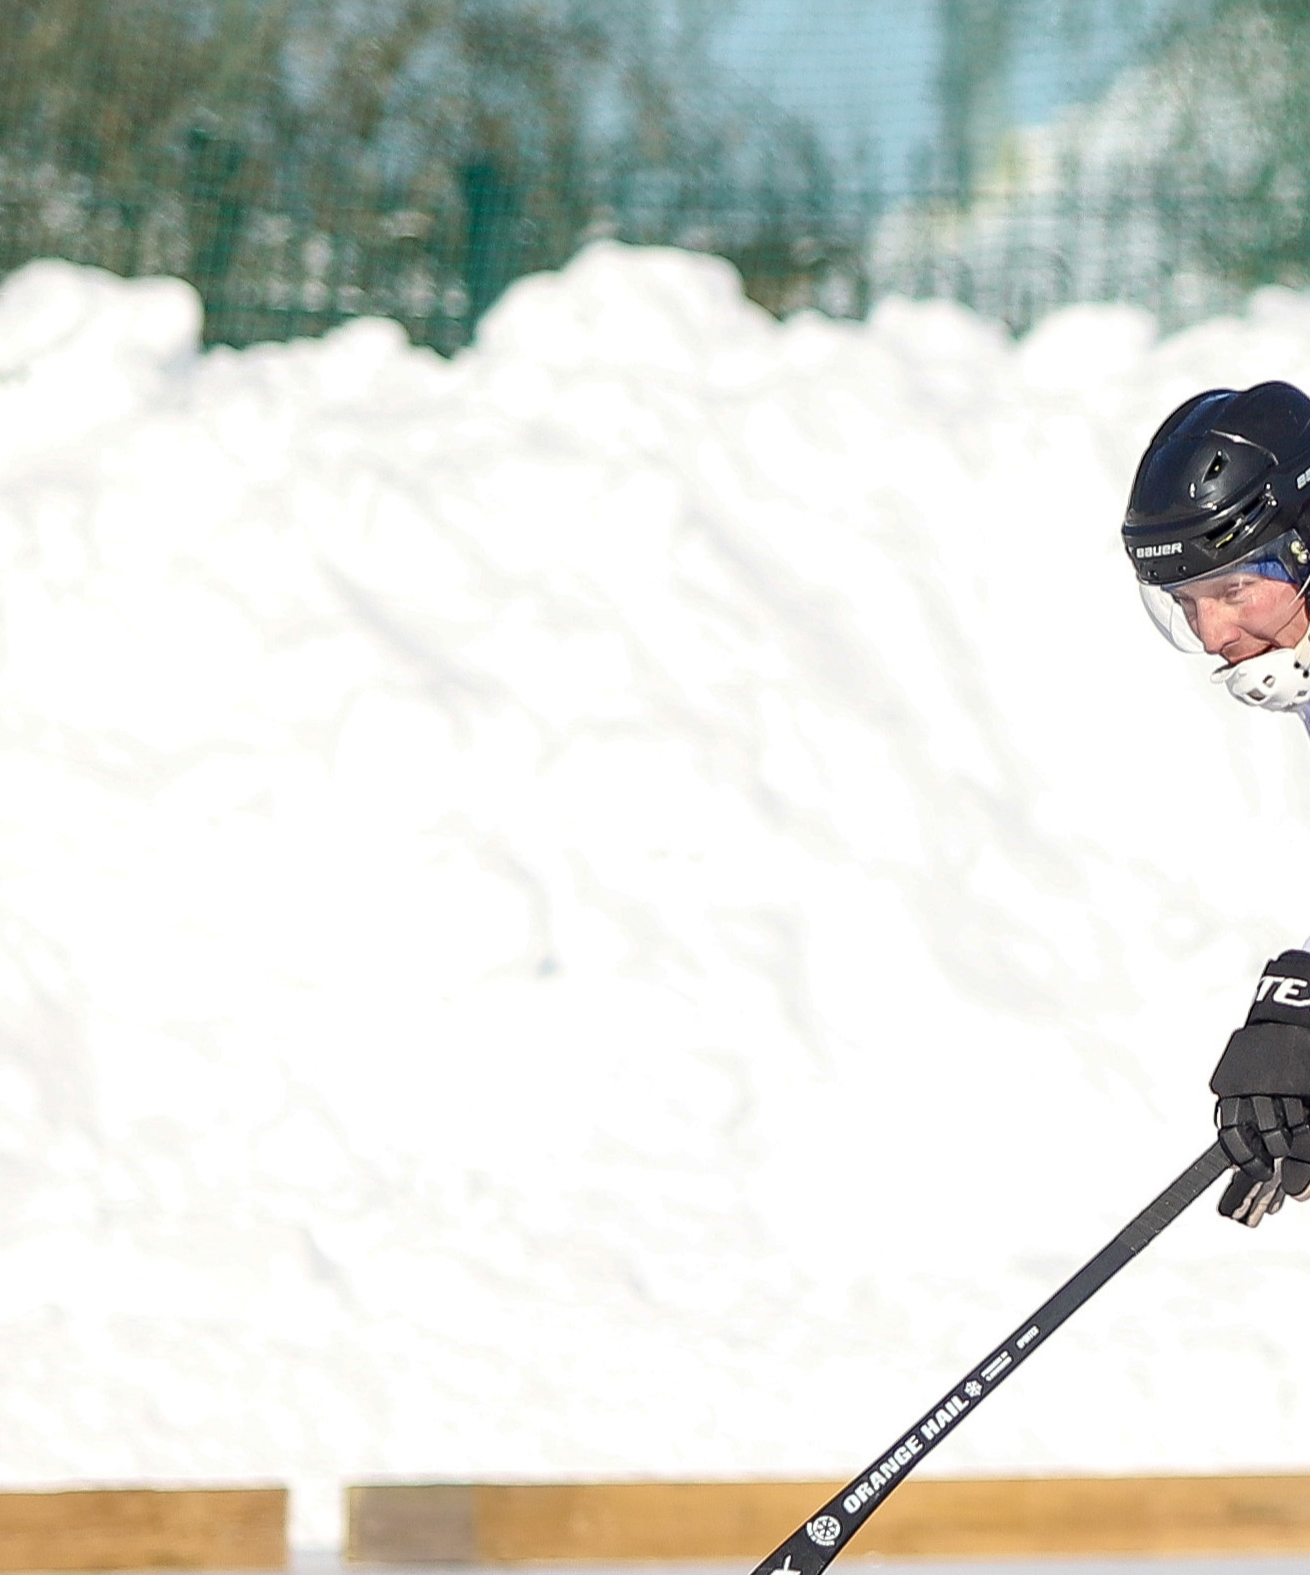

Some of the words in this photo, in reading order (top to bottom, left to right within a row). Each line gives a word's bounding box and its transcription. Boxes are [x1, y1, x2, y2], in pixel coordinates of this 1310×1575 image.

[1135, 542, 1183, 559] BAUER
[843, 1434, 924, 1514] ORANGE
[920, 1395, 970, 1440] HAIL
